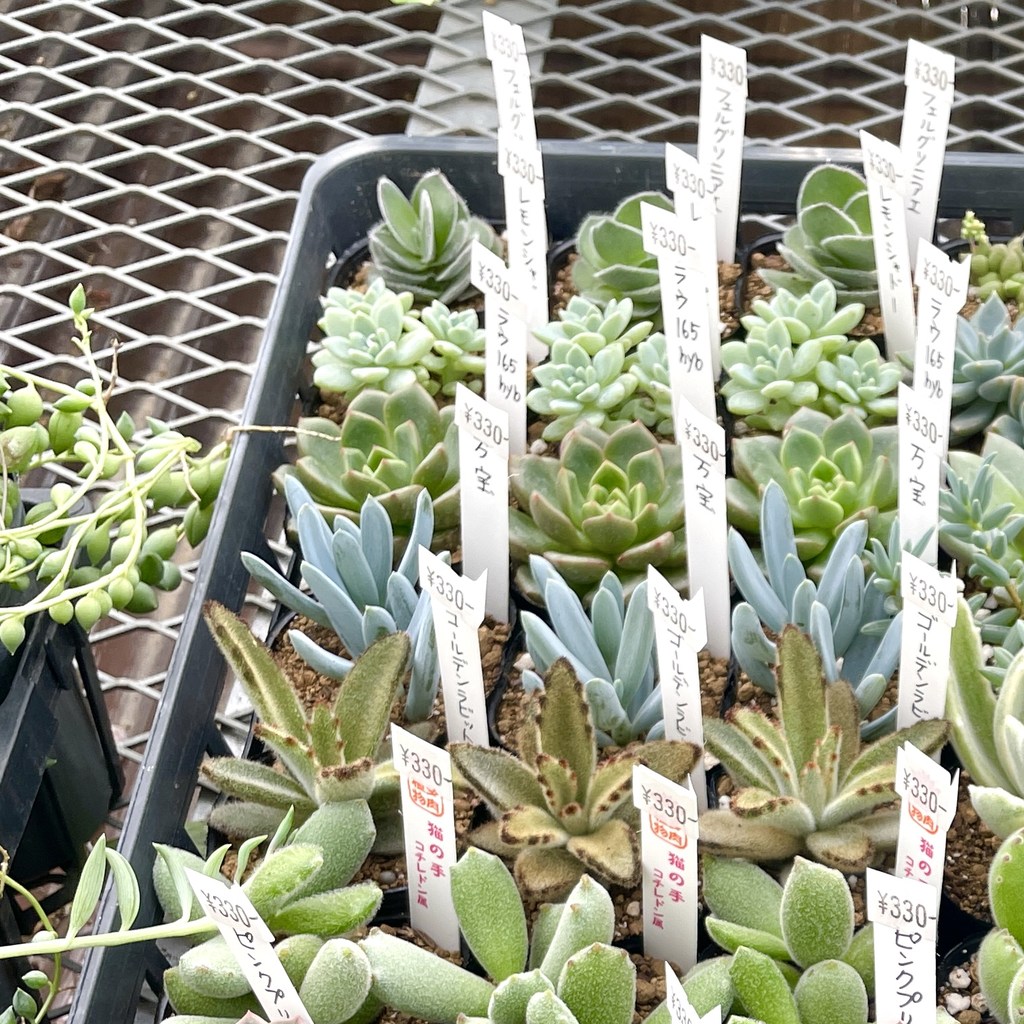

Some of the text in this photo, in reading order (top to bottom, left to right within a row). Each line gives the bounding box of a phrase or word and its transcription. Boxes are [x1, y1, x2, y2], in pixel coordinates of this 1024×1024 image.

[427, 821, 446, 878] 猫の手
[918, 837, 935, 883] 猫の
[877, 890, 937, 928] ¥330-
